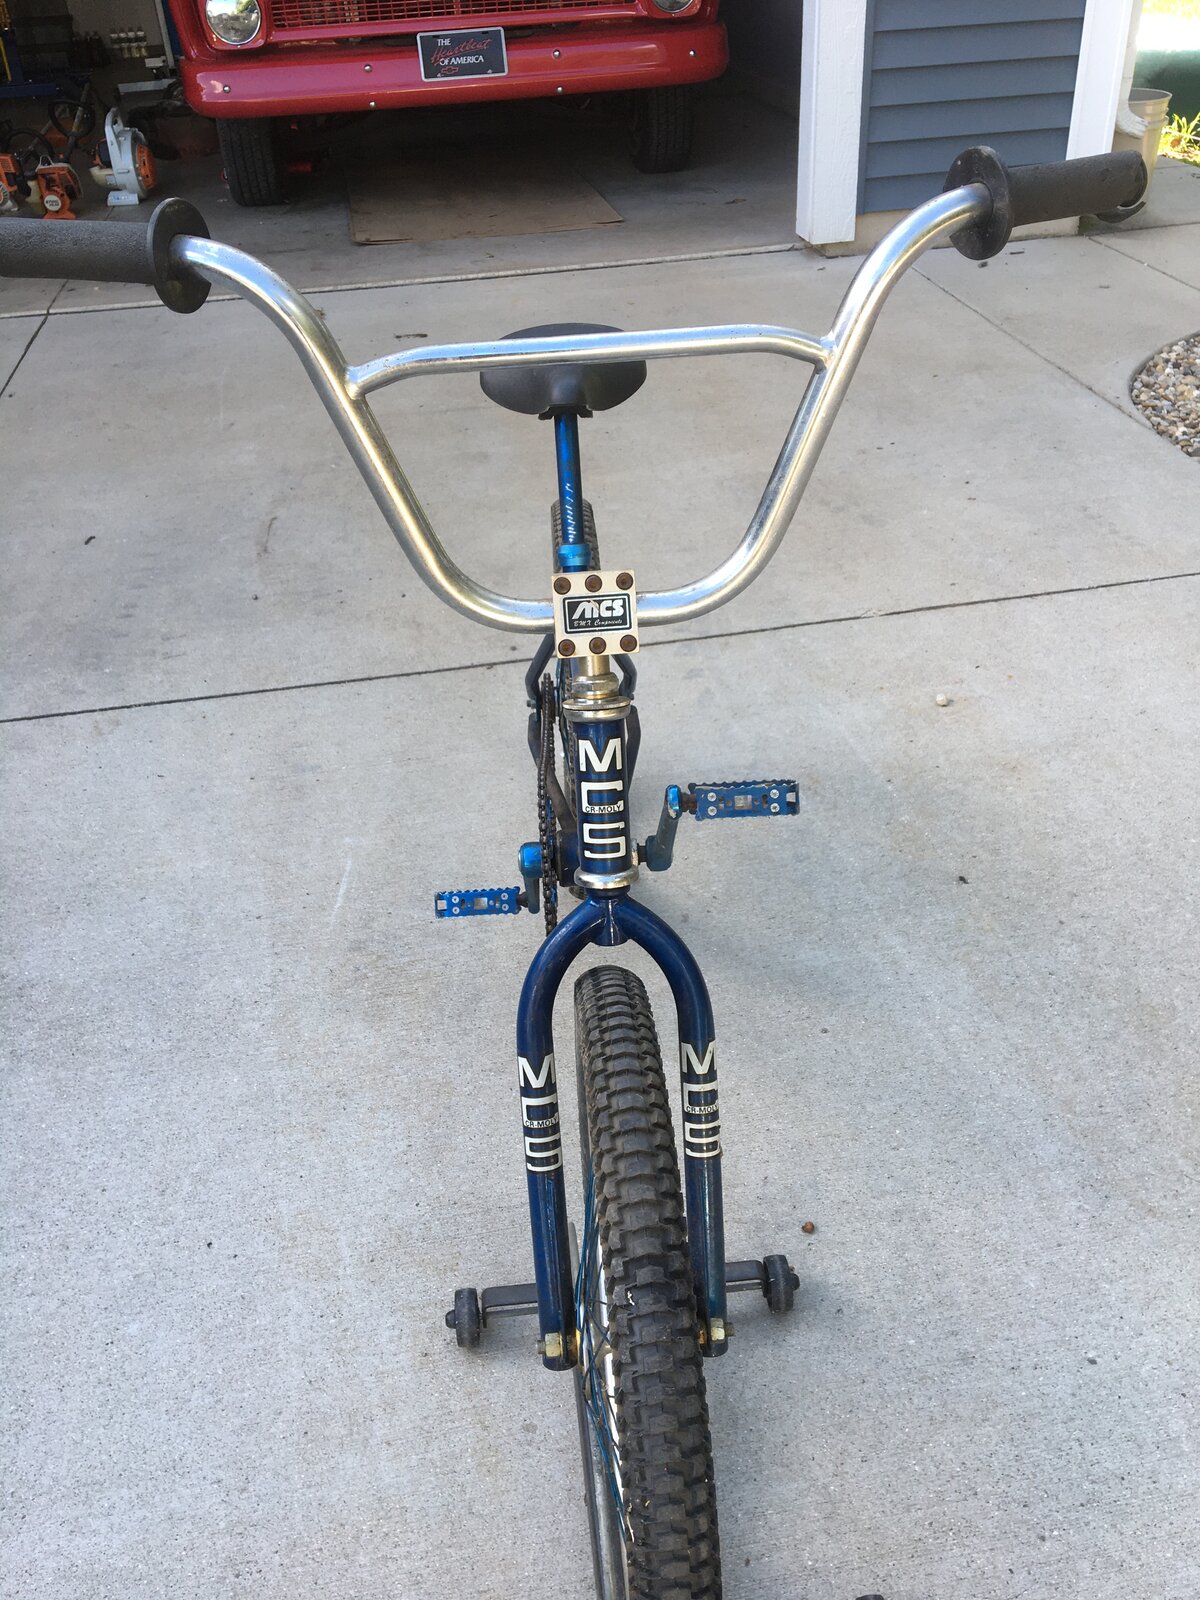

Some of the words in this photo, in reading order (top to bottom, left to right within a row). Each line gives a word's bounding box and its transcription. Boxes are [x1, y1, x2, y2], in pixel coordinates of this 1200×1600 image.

[437, 38, 452, 46] THE
[431, 38, 493, 66] Heartbeat
[440, 56, 450, 66] OF
[450, 55, 485, 65] AMERICA
[572, 599, 624, 619] MCS
[584, 805, 622, 813] CR-MOLY
[525, 1117, 559, 1129] CR-MOLY
